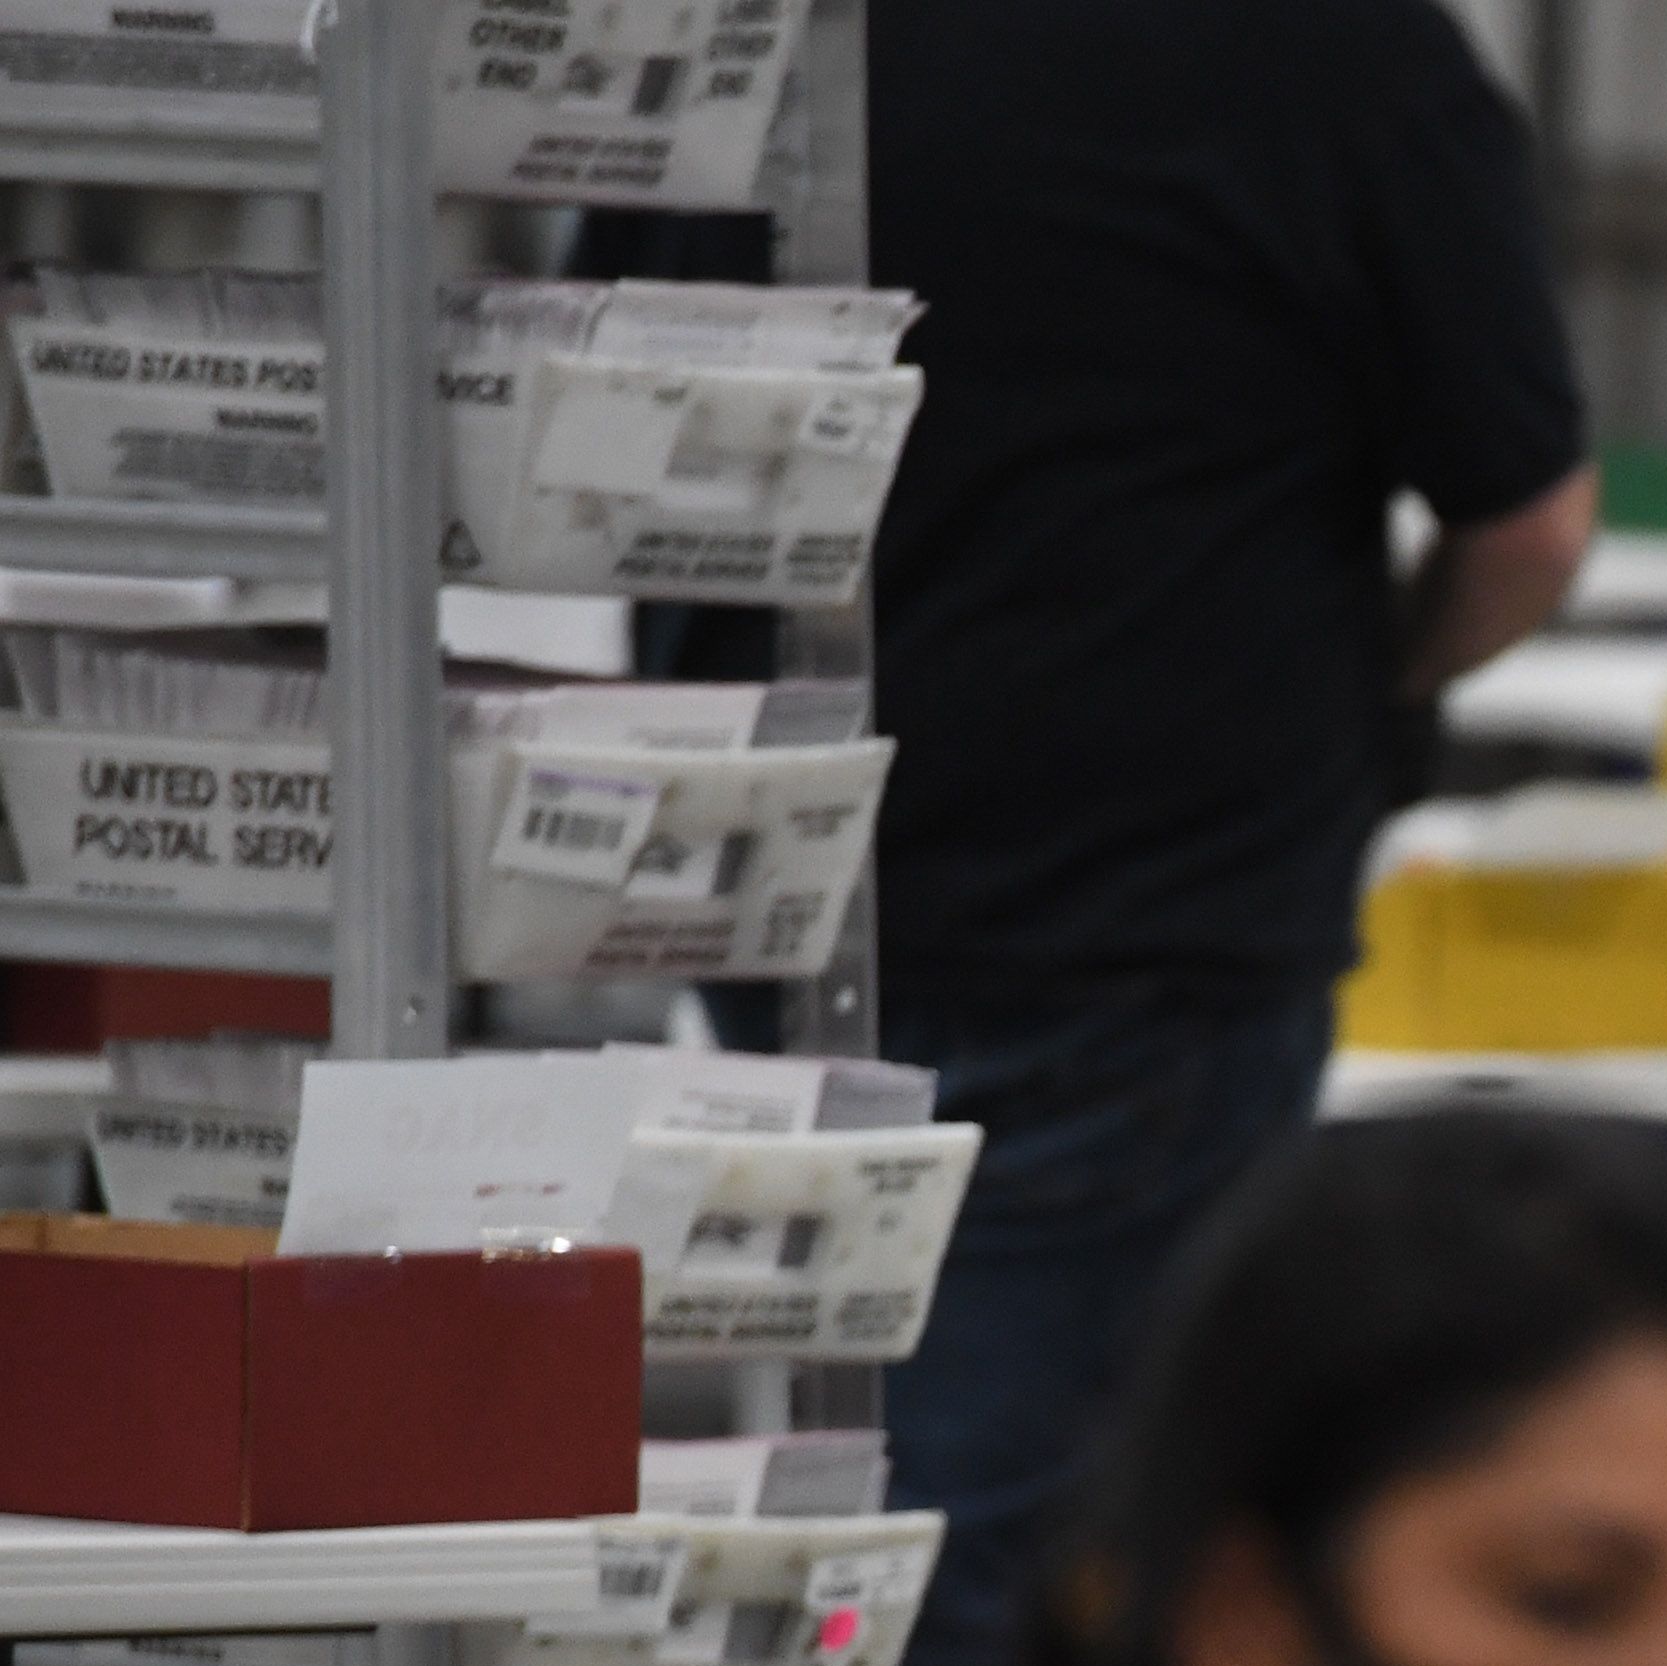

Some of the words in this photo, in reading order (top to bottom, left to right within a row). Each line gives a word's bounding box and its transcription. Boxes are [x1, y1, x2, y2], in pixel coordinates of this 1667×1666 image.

[254, 359, 319, 392] POS
[80, 758, 218, 808] UNITED
[231, 768, 330, 815] STATE
[74, 813, 218, 866] POSTAL
[234, 824, 333, 871] SERV
